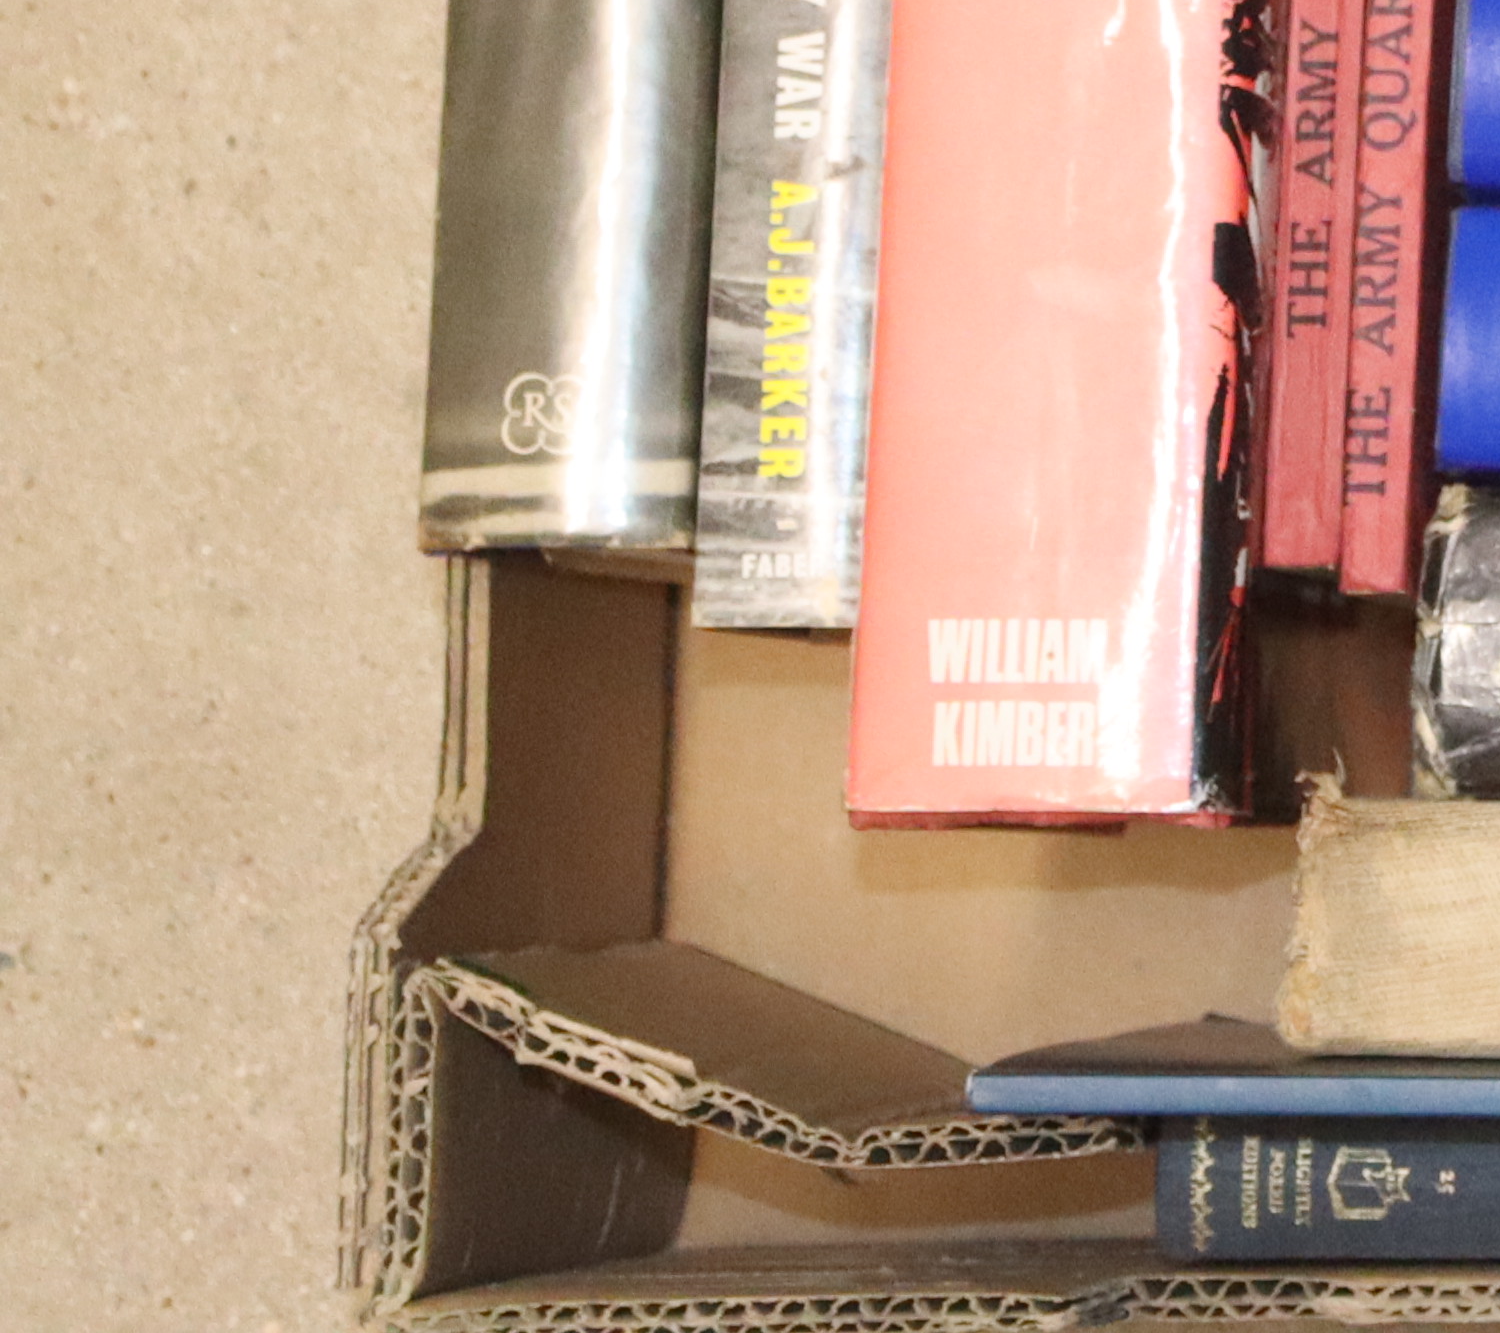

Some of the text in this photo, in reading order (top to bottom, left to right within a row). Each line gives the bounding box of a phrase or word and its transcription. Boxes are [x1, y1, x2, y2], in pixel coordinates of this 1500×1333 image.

[773, 32, 826, 142] WAR
[1295, 21, 1339, 188] ARMY
[1287, 221, 1332, 338] THE
